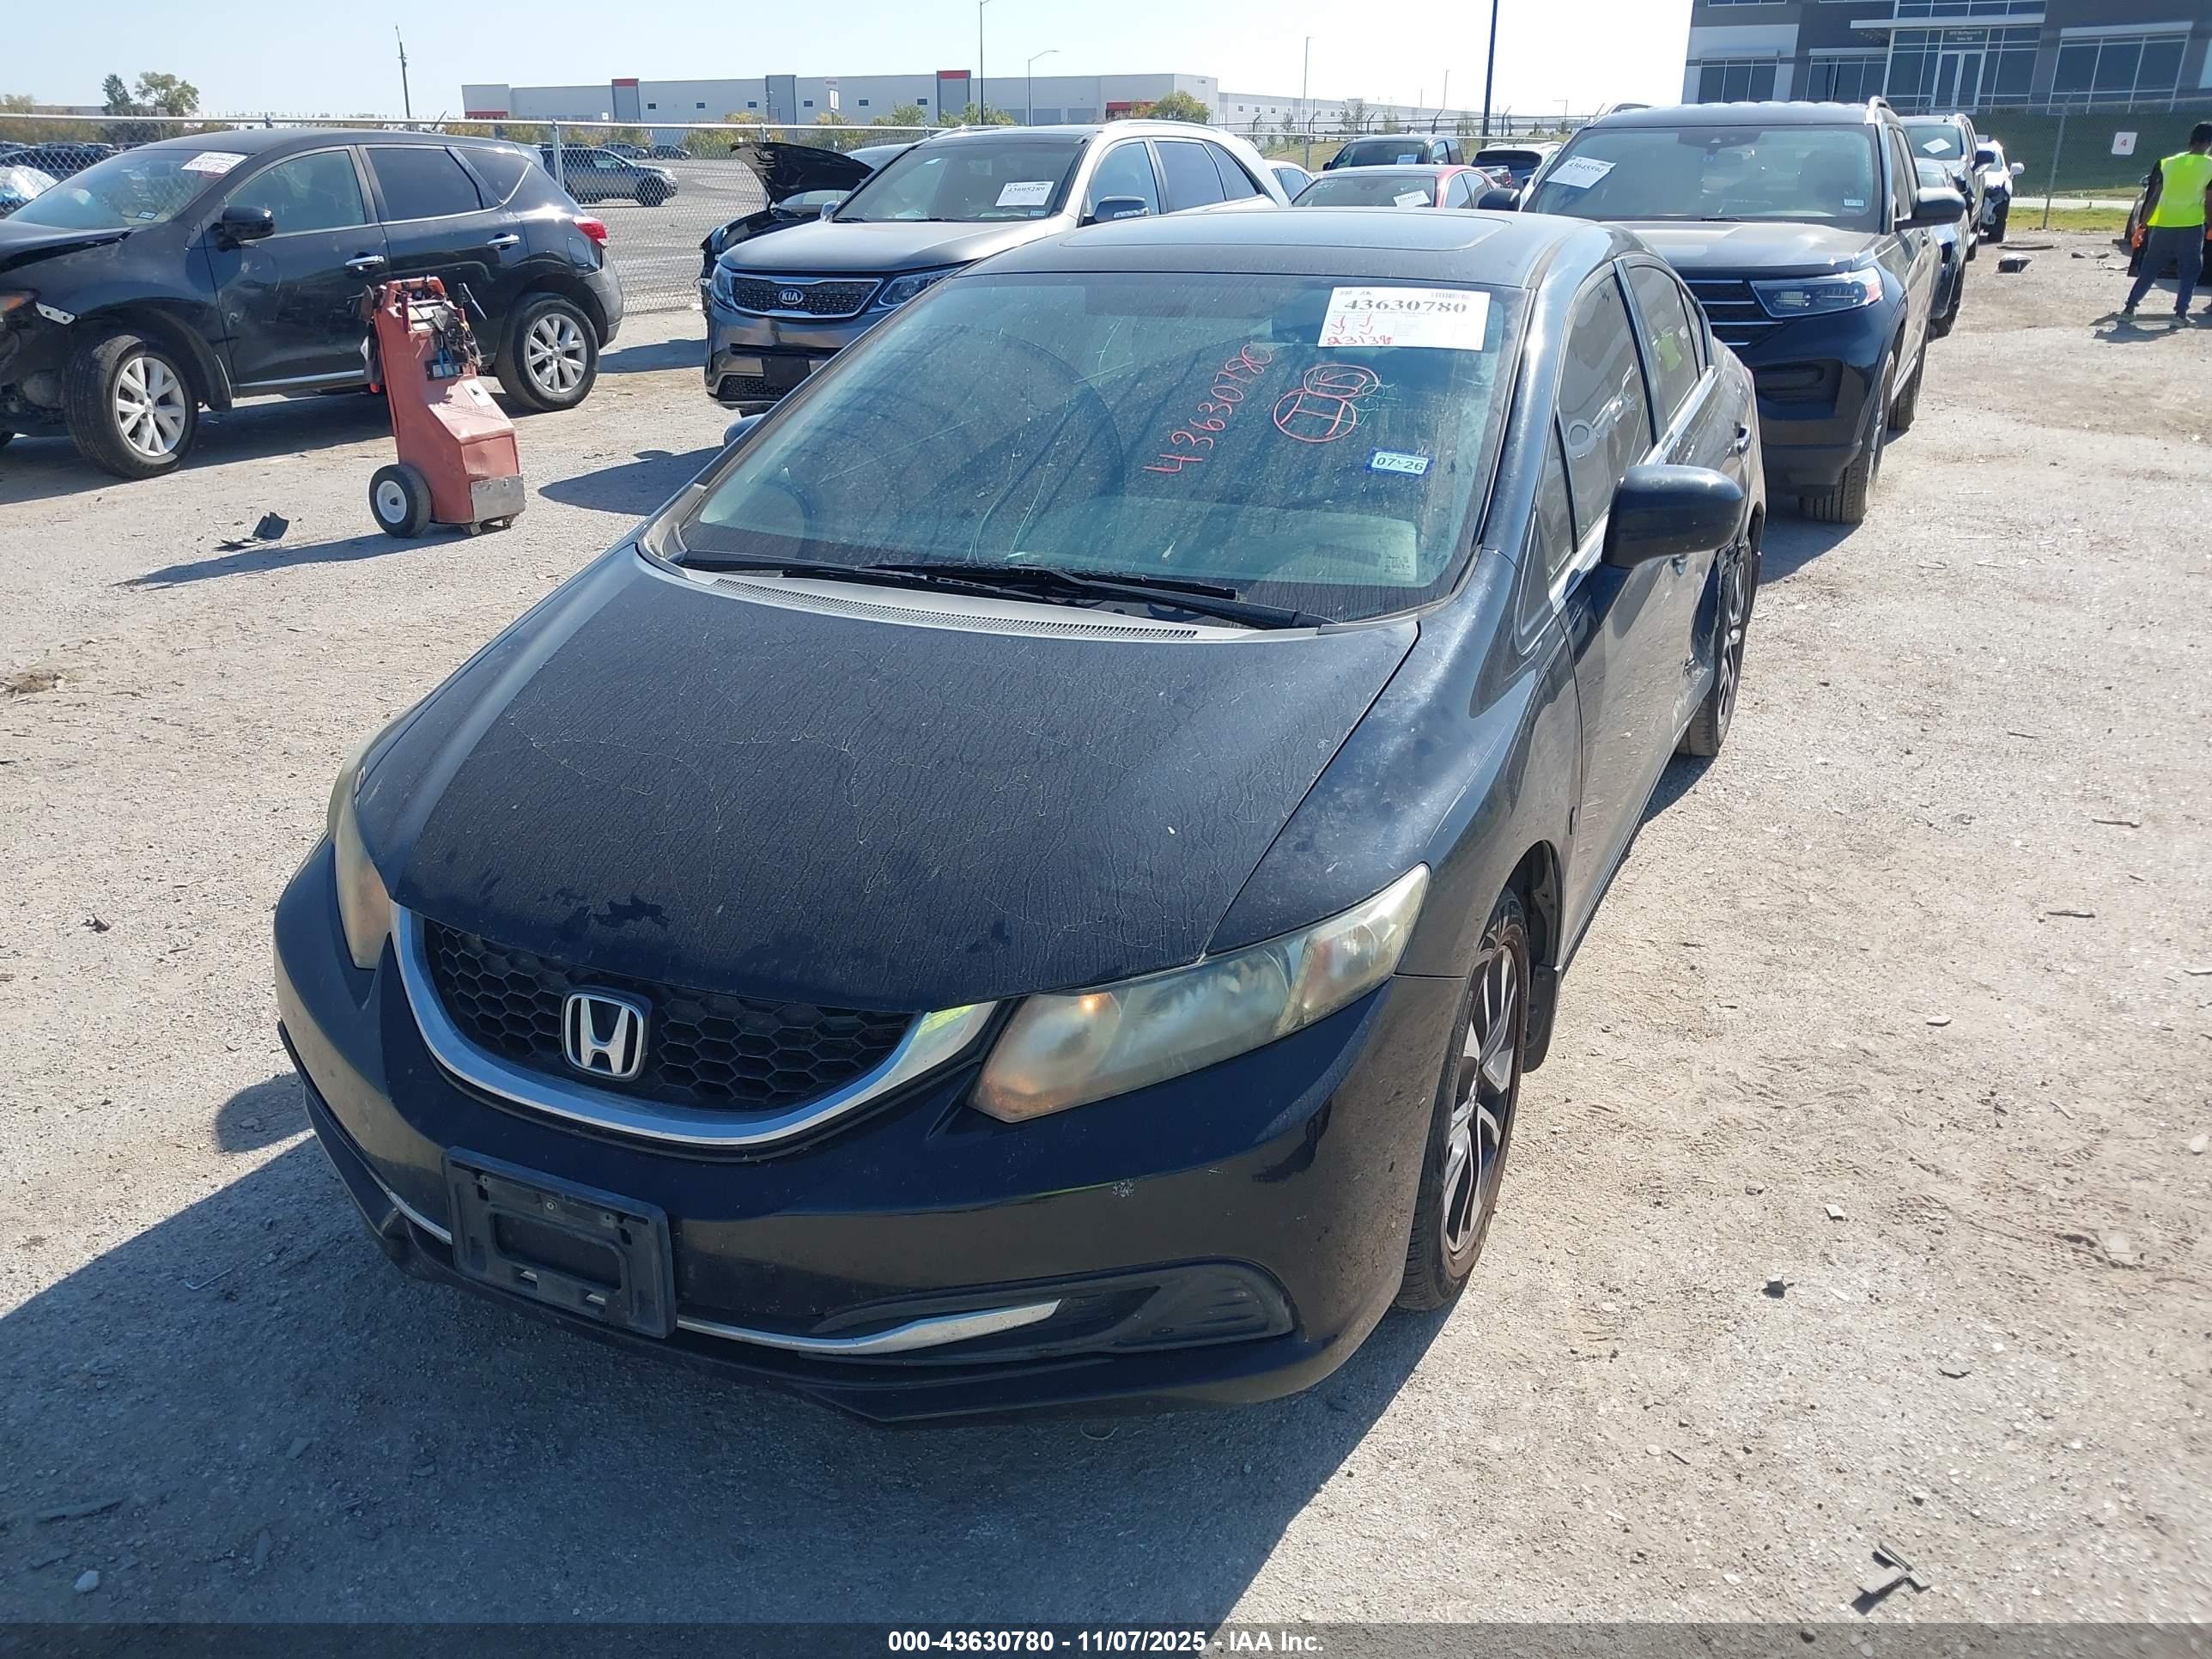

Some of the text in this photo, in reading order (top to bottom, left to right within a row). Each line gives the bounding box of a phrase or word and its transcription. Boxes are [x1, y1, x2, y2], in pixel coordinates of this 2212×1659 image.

[781, 291, 799, 301] KIA
[1344, 298, 1468, 314] 43630780
[1143, 343, 1273, 473] 43630780
[1376, 457, 1398, 467] 07
[1402, 460, 1425, 471] 26
